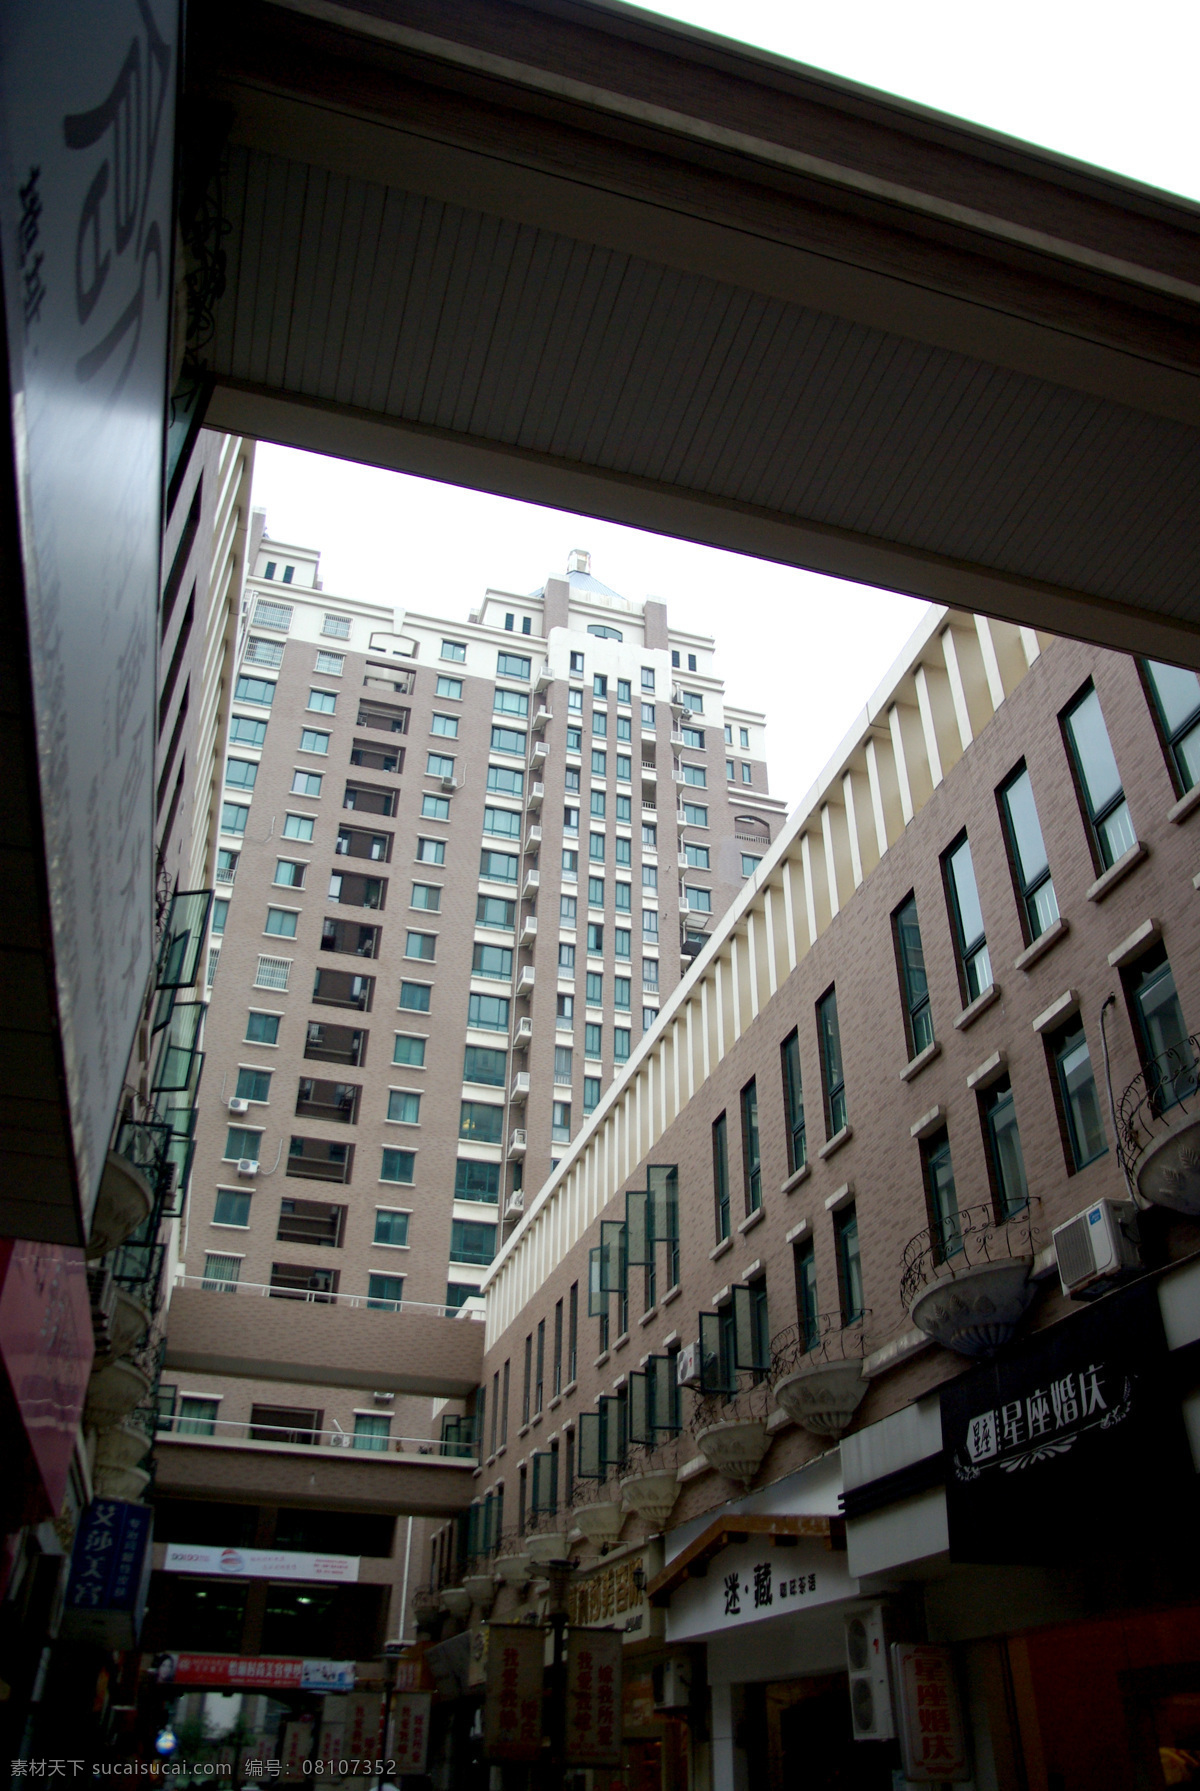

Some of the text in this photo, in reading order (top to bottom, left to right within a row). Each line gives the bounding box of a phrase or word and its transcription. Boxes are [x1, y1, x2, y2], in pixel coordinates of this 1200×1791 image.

[1001, 1362, 1109, 1451] 星座婚庆
[914, 1658, 953, 1760] 星座婚庆
